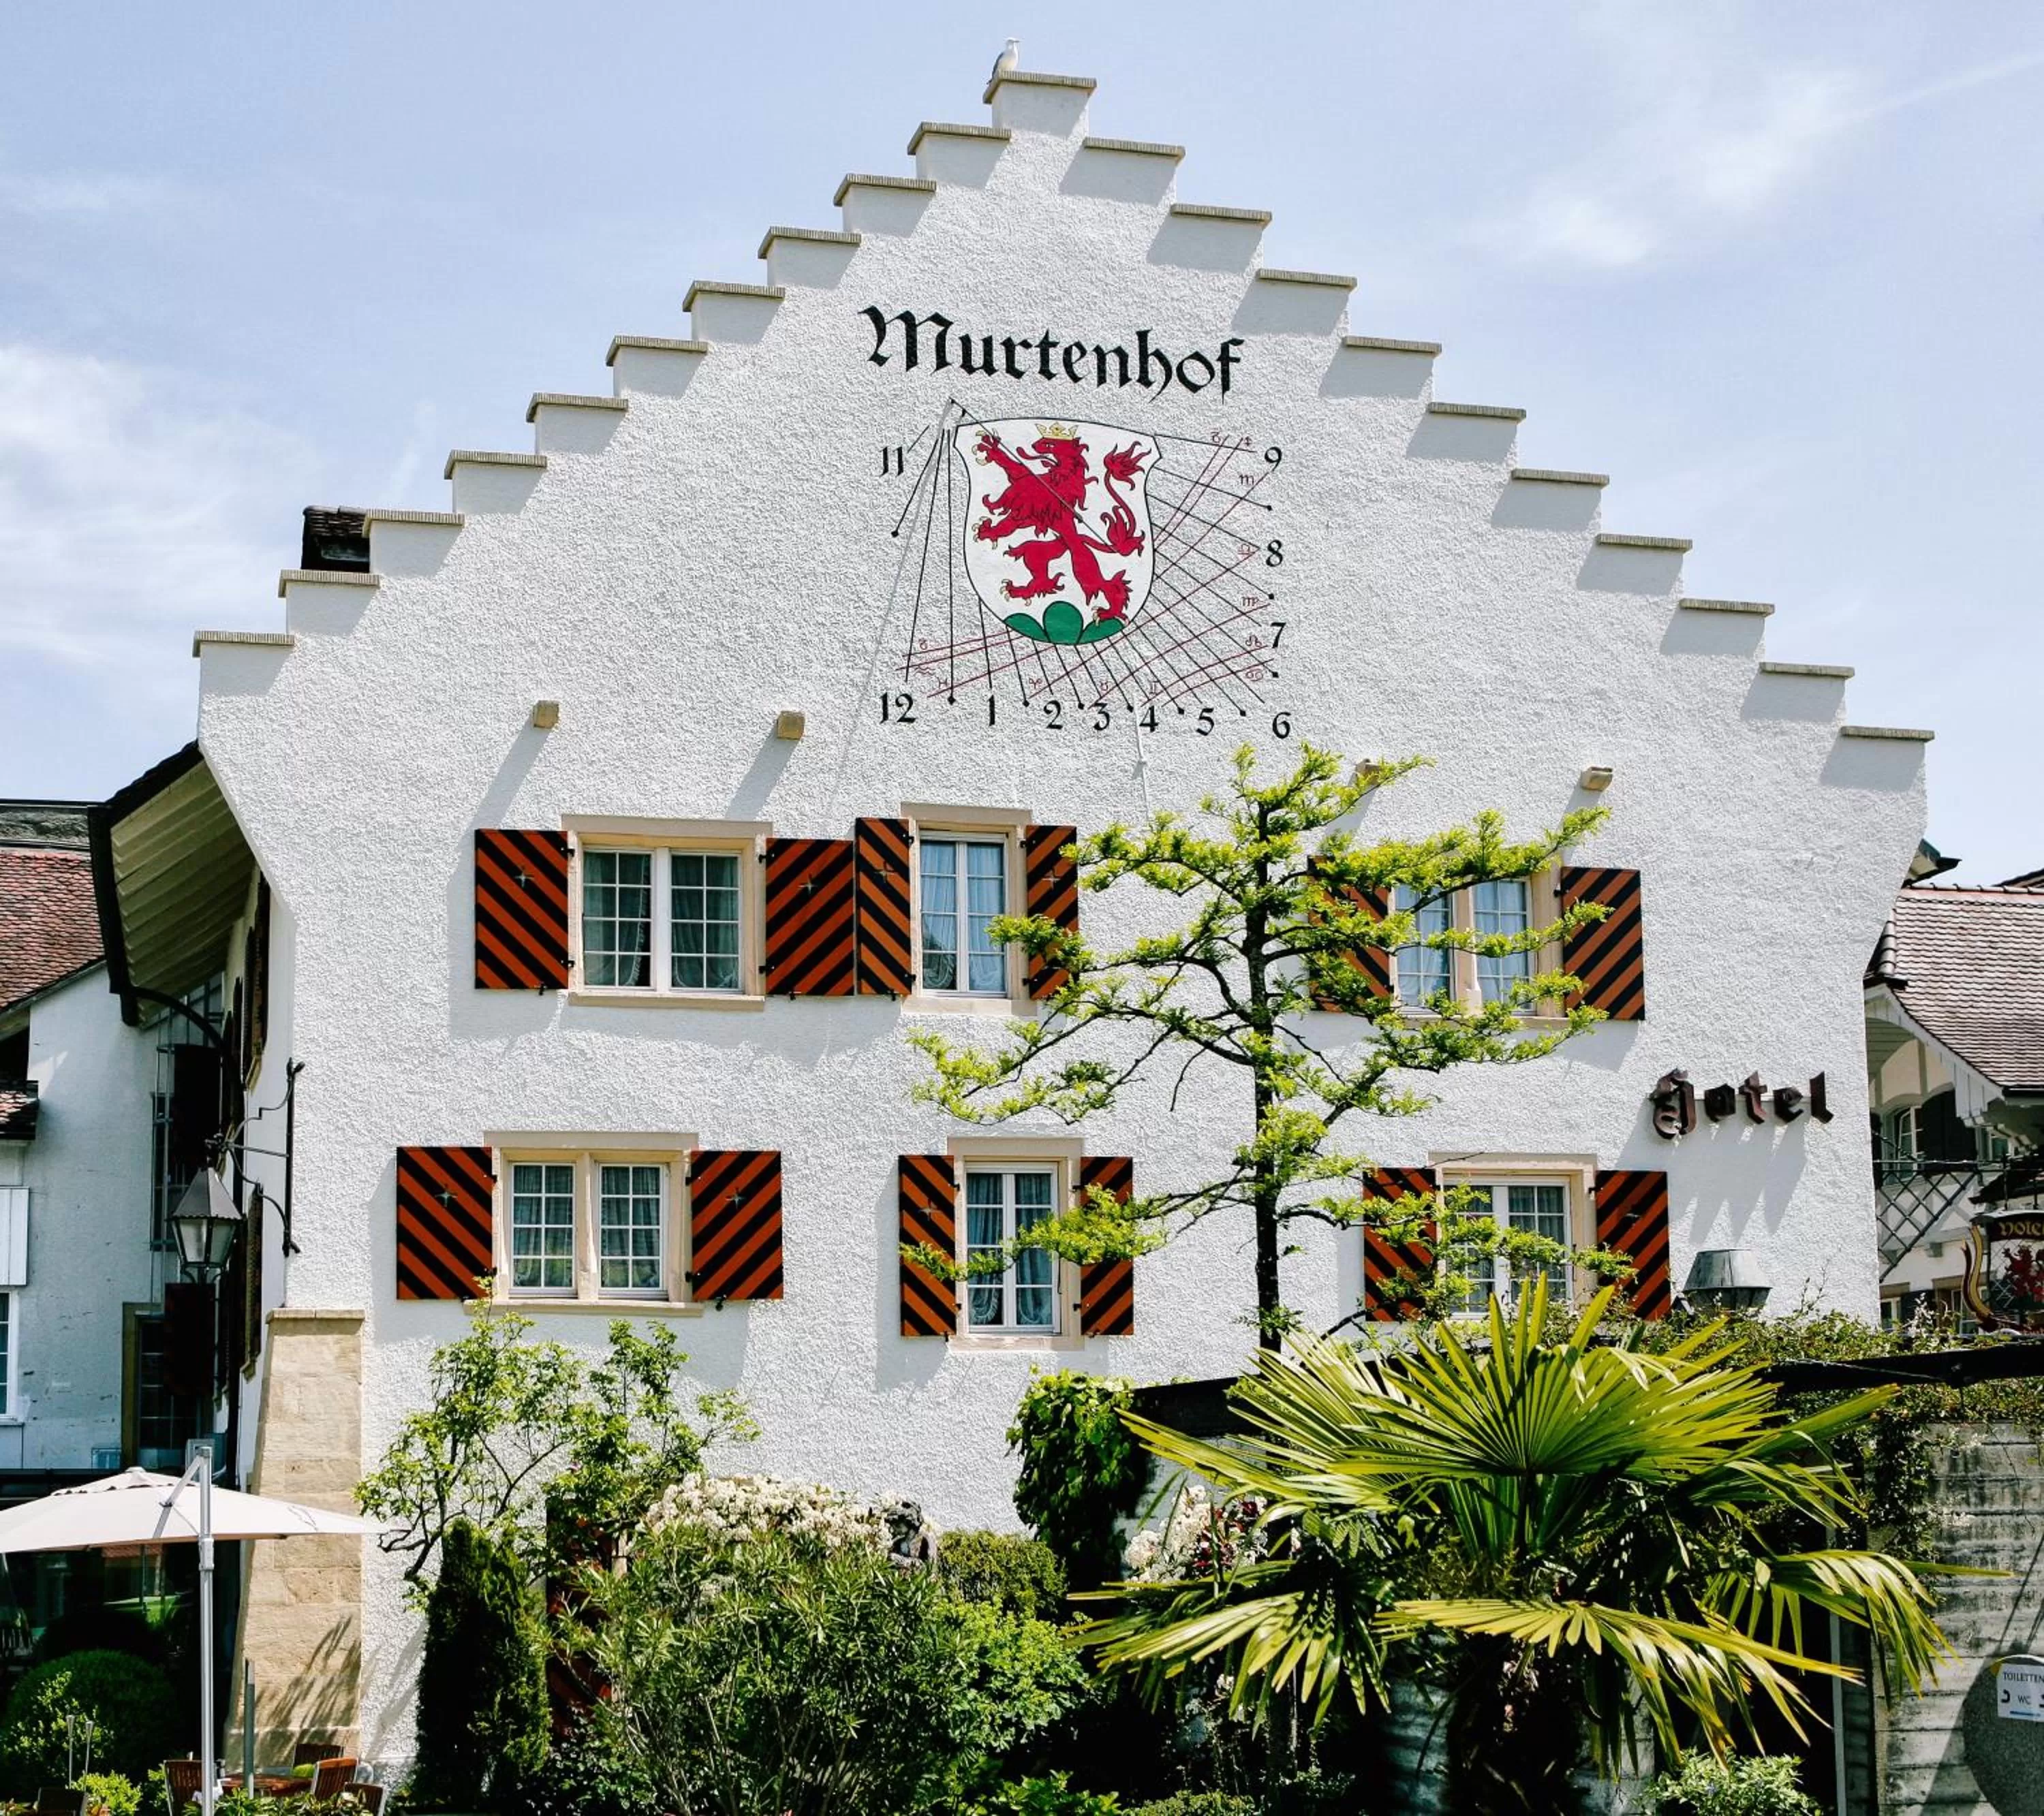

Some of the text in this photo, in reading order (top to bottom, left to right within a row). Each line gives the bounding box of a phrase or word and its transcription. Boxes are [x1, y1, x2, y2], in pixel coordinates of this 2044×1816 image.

[858, 305, 1245, 406] Murtenhof
[880, 445, 905, 476] 11
[1263, 446, 1283, 469] 9
[1265, 539, 1284, 567] 8
[1269, 622, 1286, 649] 7
[880, 692, 1292, 739] 12 1 2 3 4 5 6
[2017, 1694, 2032, 1705] WC
